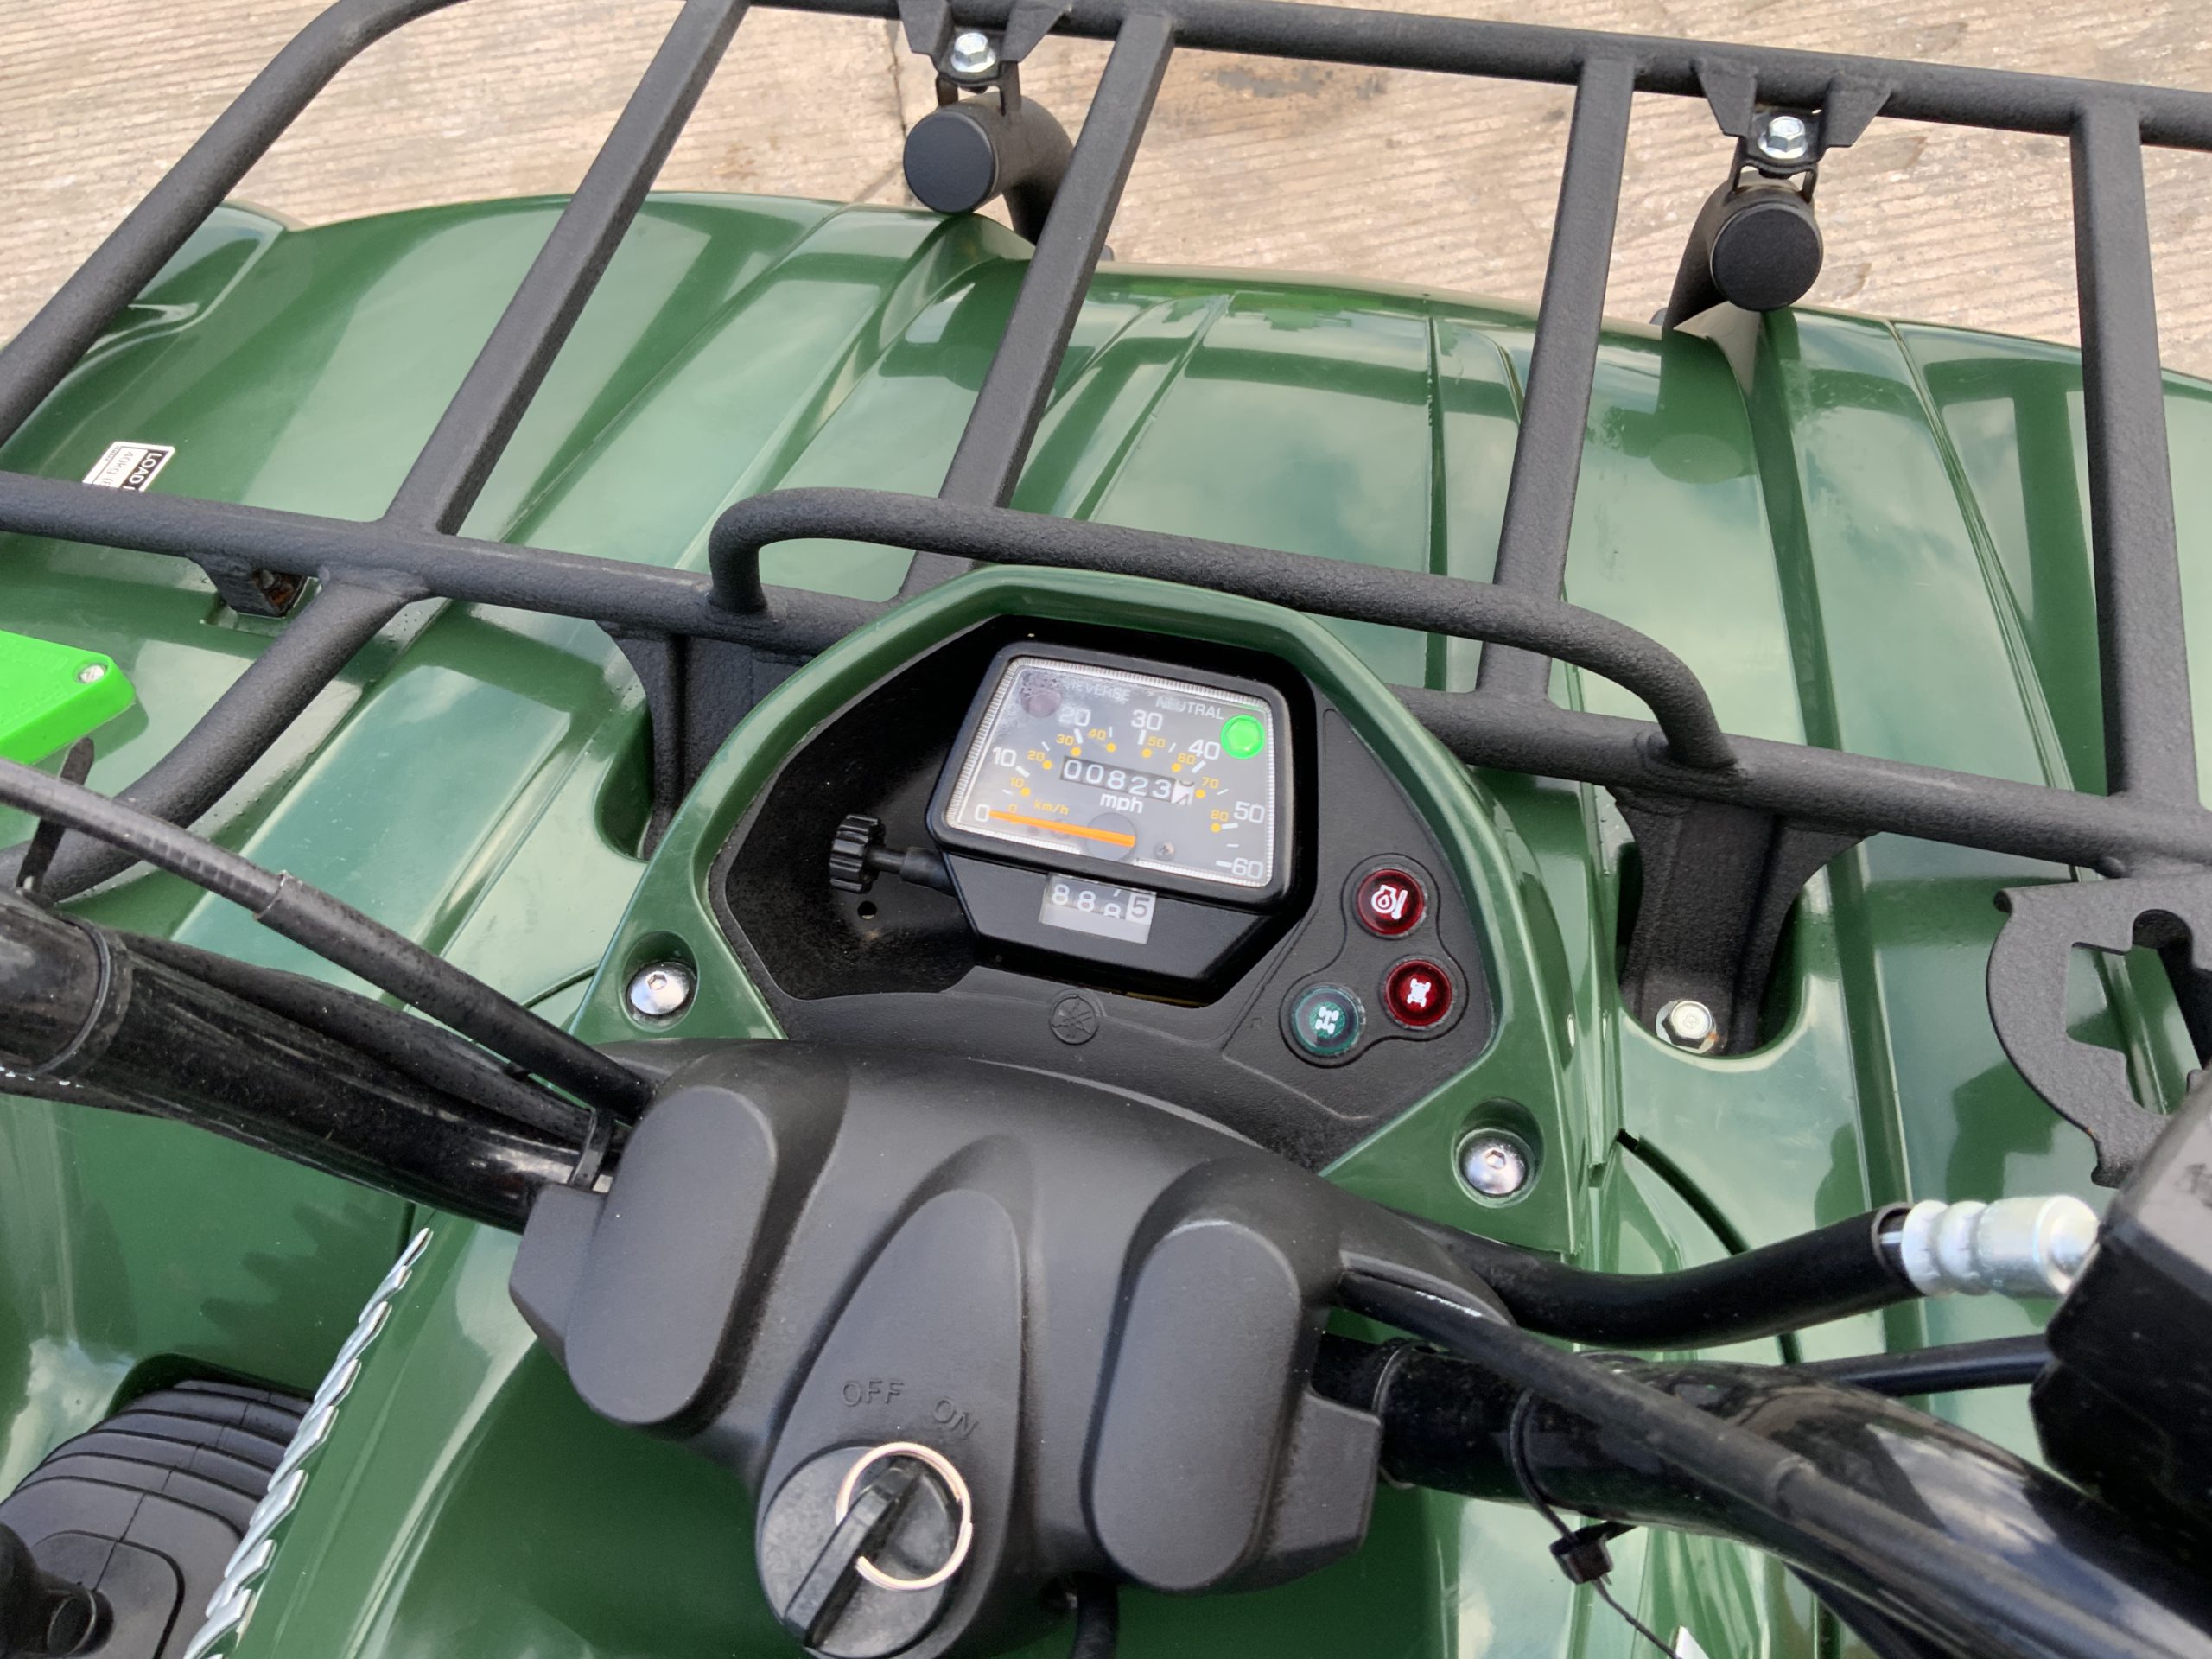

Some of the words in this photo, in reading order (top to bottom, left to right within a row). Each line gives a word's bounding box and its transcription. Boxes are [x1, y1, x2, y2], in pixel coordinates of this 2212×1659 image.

[128, 452, 162, 485] LOAD
[1058, 704, 1091, 727] 20
[1155, 696, 1224, 721] NEUTRAL
[1130, 709, 1163, 731] 30
[1056, 734, 1074, 747] 30
[1088, 728, 1107, 741] 40
[1147, 735, 1166, 748] 50
[993, 747, 1017, 767] 10
[1027, 750, 1046, 762] 20
[1177, 753, 1196, 765] 60
[1188, 739, 1221, 760] 40
[1010, 777, 1024, 788] 10
[1202, 777, 1219, 789] 70
[975, 804, 990, 822] 0
[1033, 799, 1069, 816] km/h
[1100, 793, 1144, 814] mph
[1233, 800, 1265, 823] 50
[1210, 810, 1229, 822] 80
[1231, 857, 1264, 880] 60
[842, 1379, 905, 1408] OFF
[932, 1395, 980, 1440] ON
